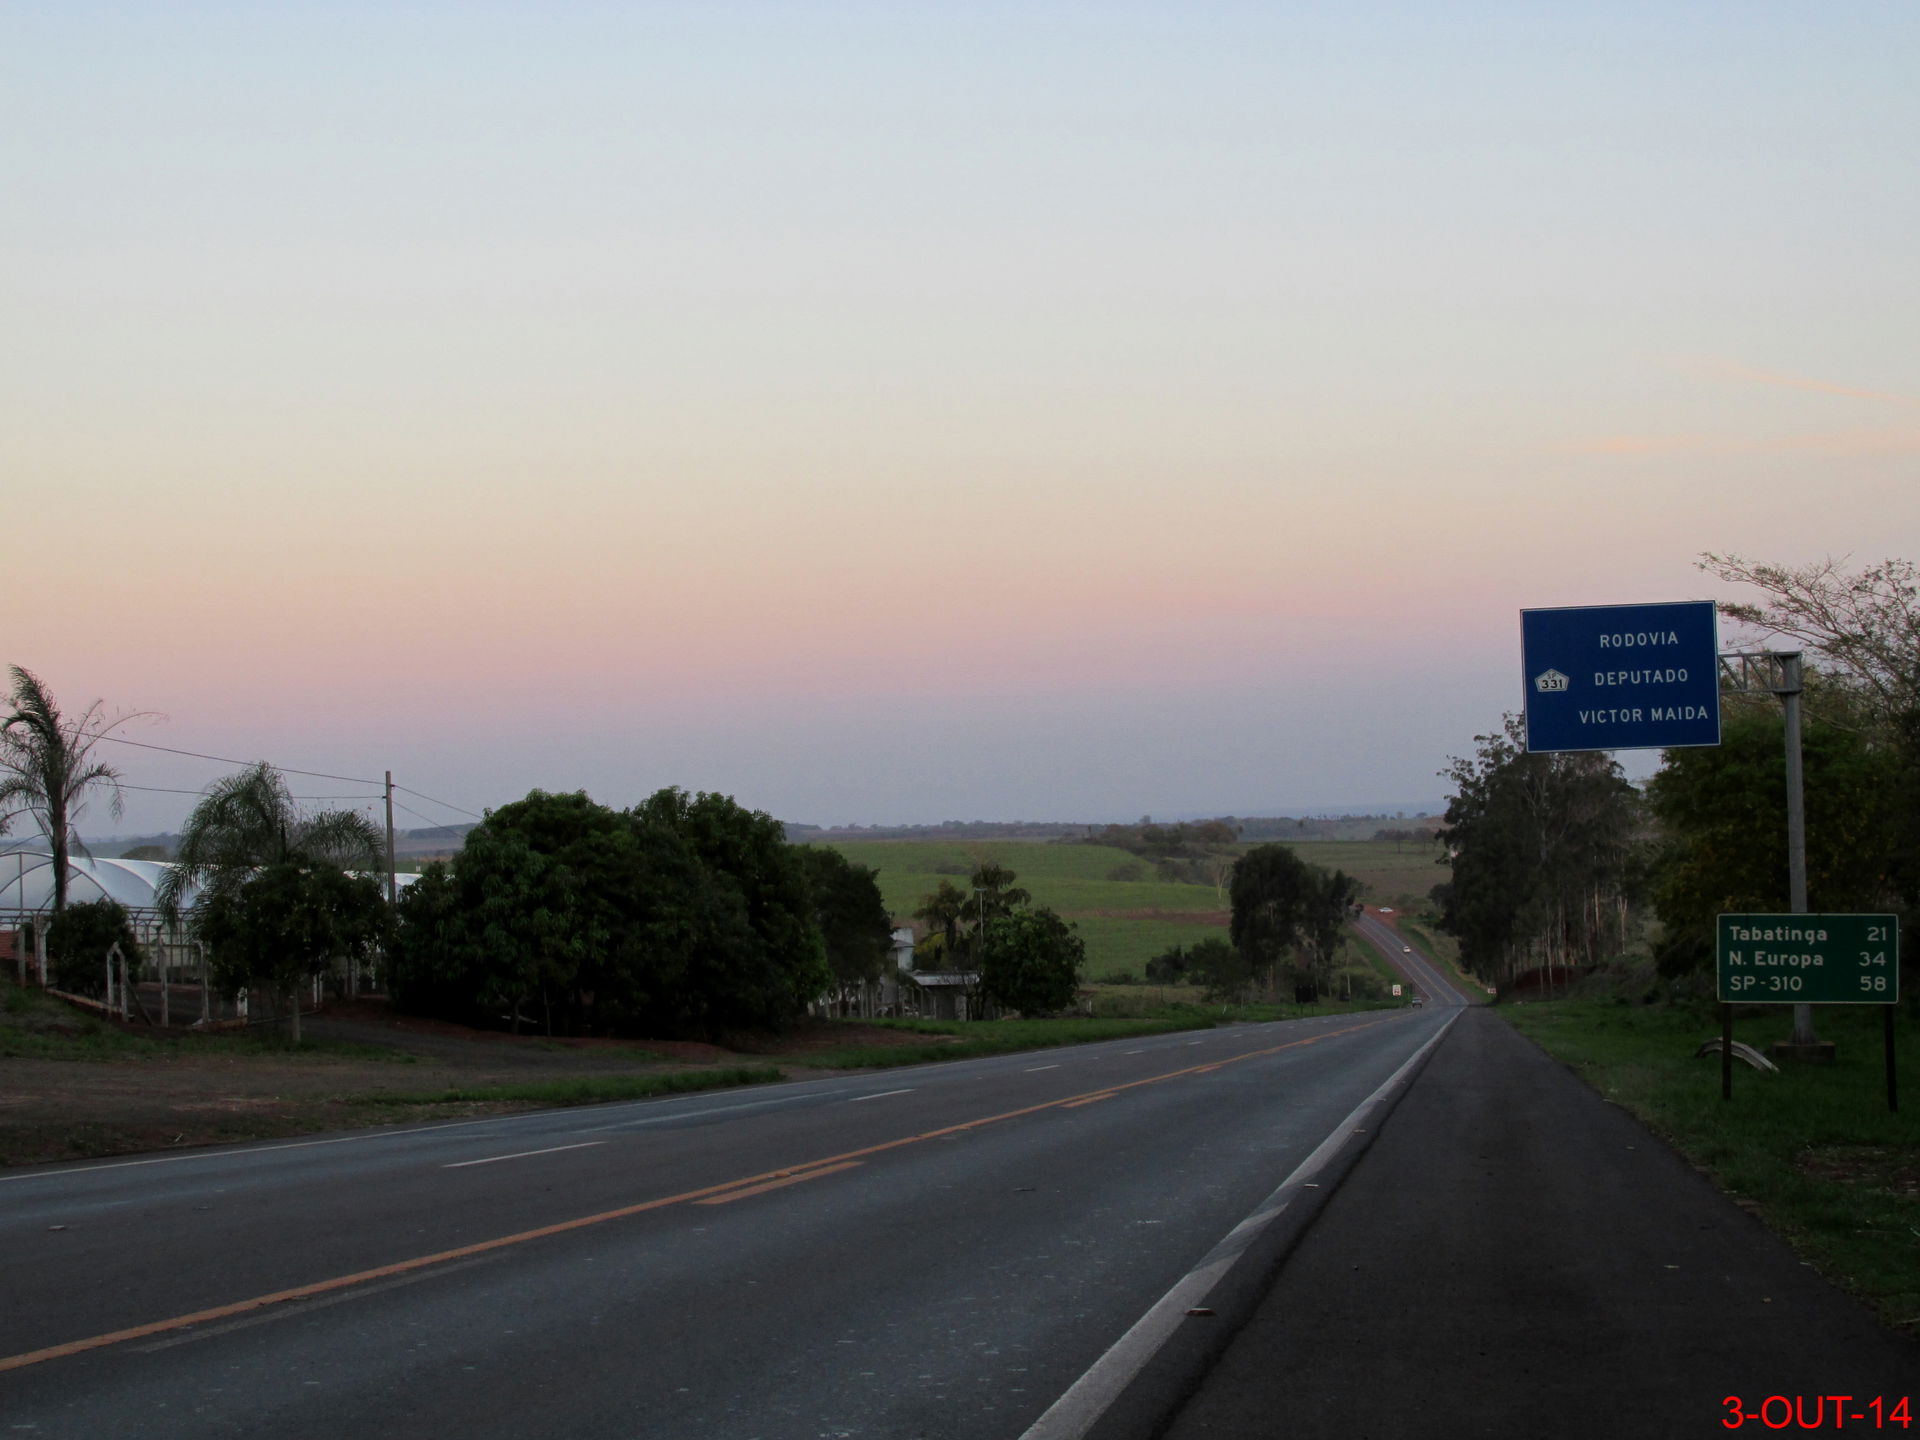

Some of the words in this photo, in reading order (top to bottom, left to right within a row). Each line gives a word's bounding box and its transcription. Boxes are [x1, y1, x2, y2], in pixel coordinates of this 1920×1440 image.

[1600, 631, 1679, 648] RODOVIA
[1541, 679, 1563, 689] 331
[1594, 668, 1688, 686] DEPUTADO
[1578, 708, 1643, 724] VICTOR
[1651, 706, 1709, 721] MAIDA
[1729, 926, 1828, 945] Tabatinga
[1867, 926, 1887, 941] 21
[1729, 951, 1747, 966] N.
[1754, 951, 1824, 968] Europa
[1859, 952, 1887, 966] 34
[1860, 976, 1887, 991] 58
